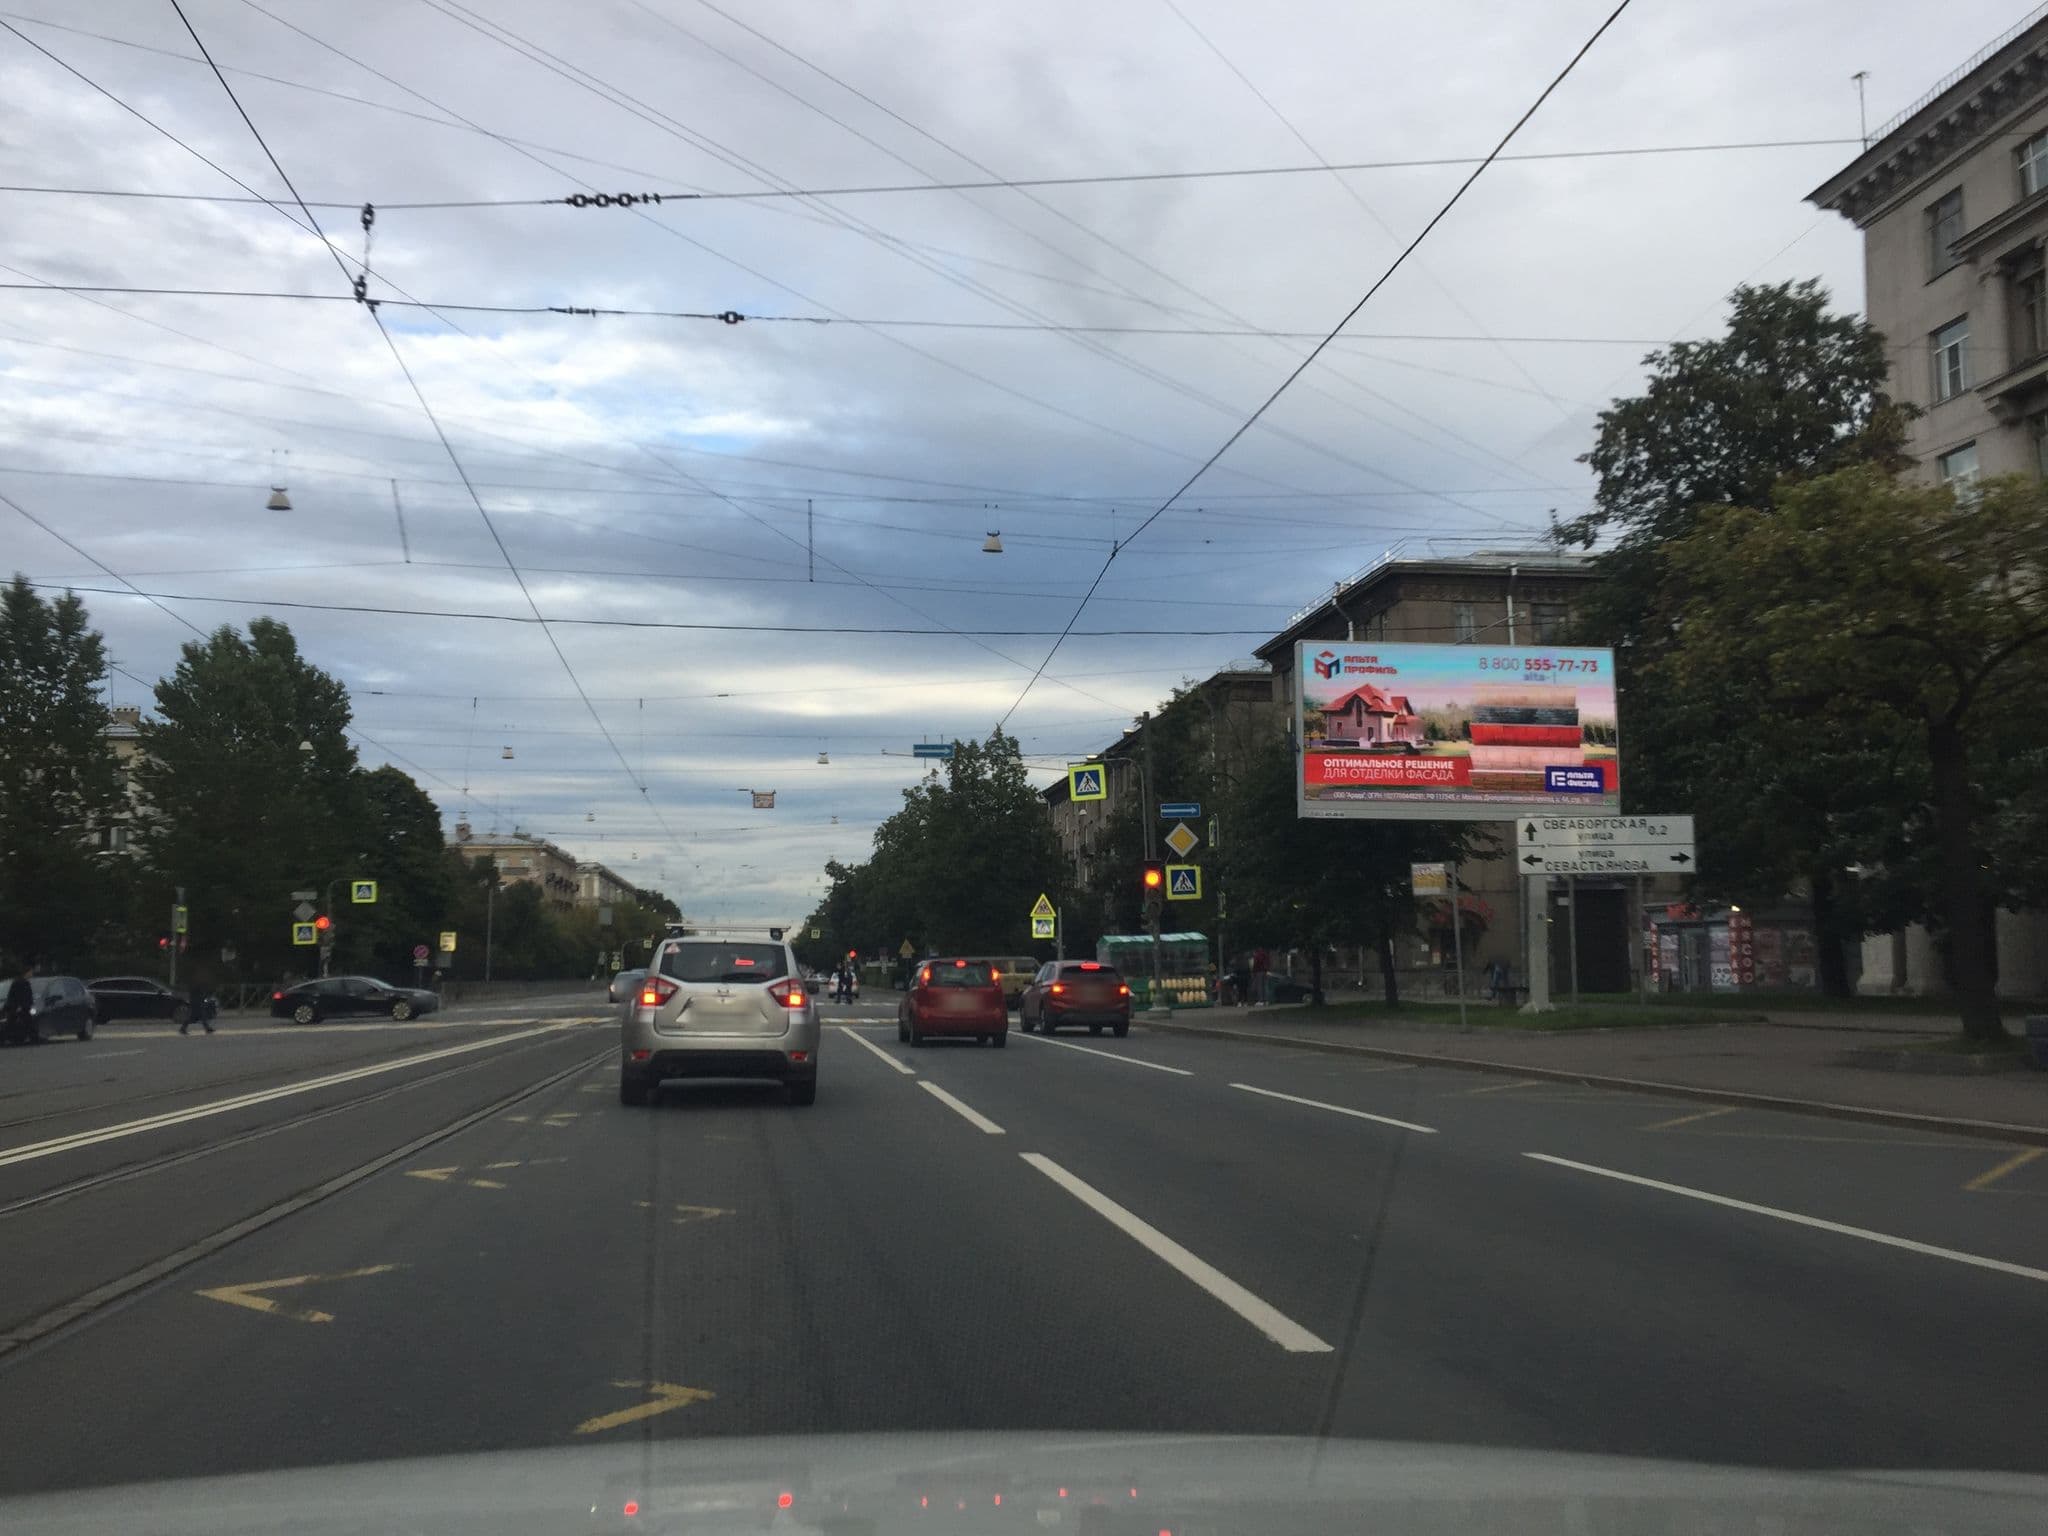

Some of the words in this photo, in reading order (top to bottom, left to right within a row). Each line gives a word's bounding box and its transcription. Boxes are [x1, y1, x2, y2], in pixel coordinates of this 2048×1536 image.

[1344, 666, 1397, 674] ПРОФИЛЬ
[1479, 657, 1488, 670] 8
[1492, 657, 1520, 671] 800
[1524, 658, 1598, 673] 555-77-73
[1323, 758, 1403, 769] ОПТИМАЛЬНОЕ
[1405, 760, 1454, 770] РЕШЕНИЕ
[1323, 768, 1347, 778] ДЛЯ
[1350, 768, 1403, 779] ОТДЕЛКИ
[1406, 769, 1454, 780] ФАСАДА
[1543, 818, 1647, 830] СВЕАБОРГСКАЯ
[1577, 832, 1614, 841] улица
[1577, 849, 1615, 858] улица
[1544, 860, 1649, 872] СЕВАСТЬЯНОВА
